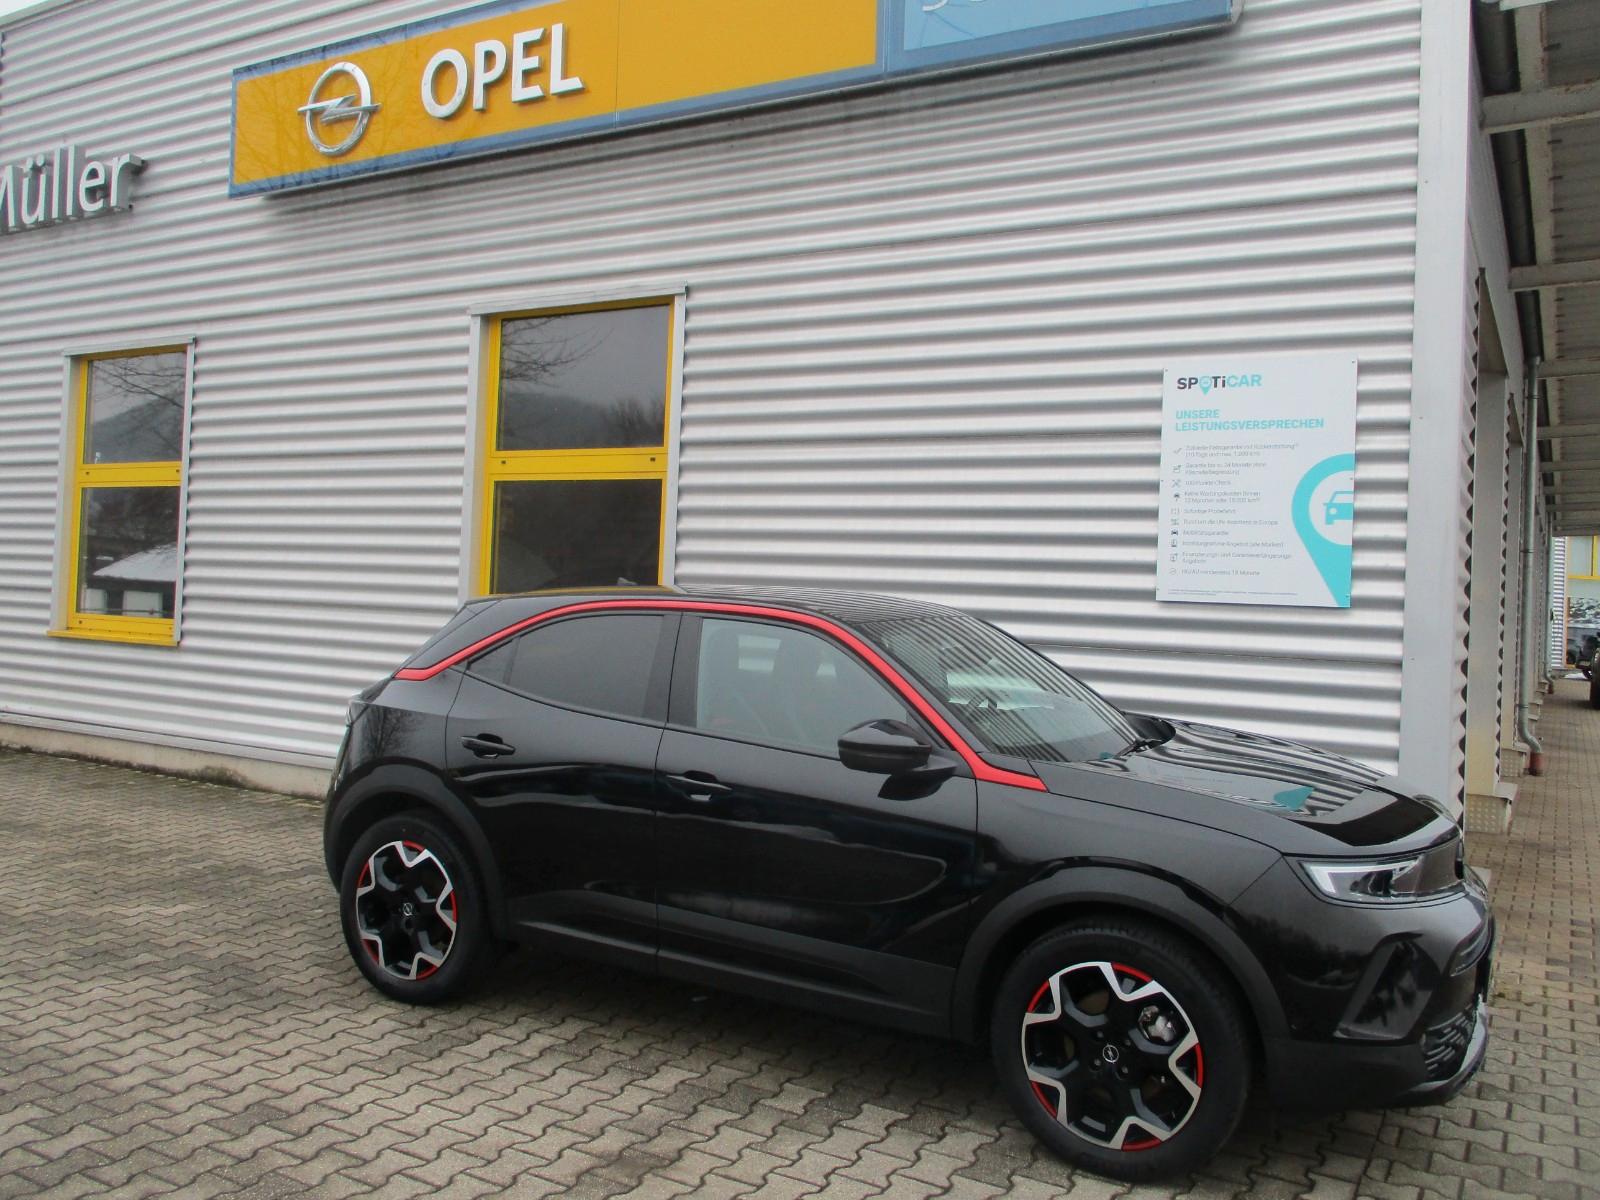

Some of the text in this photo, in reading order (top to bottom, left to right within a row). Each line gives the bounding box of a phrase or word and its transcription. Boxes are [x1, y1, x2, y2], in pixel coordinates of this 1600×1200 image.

[421, 23, 585, 119] OPEL
[1175, 409, 1220, 420] UNSERE
[1175, 418, 1324, 432] LEISTUNGSVERSPRECHEN
